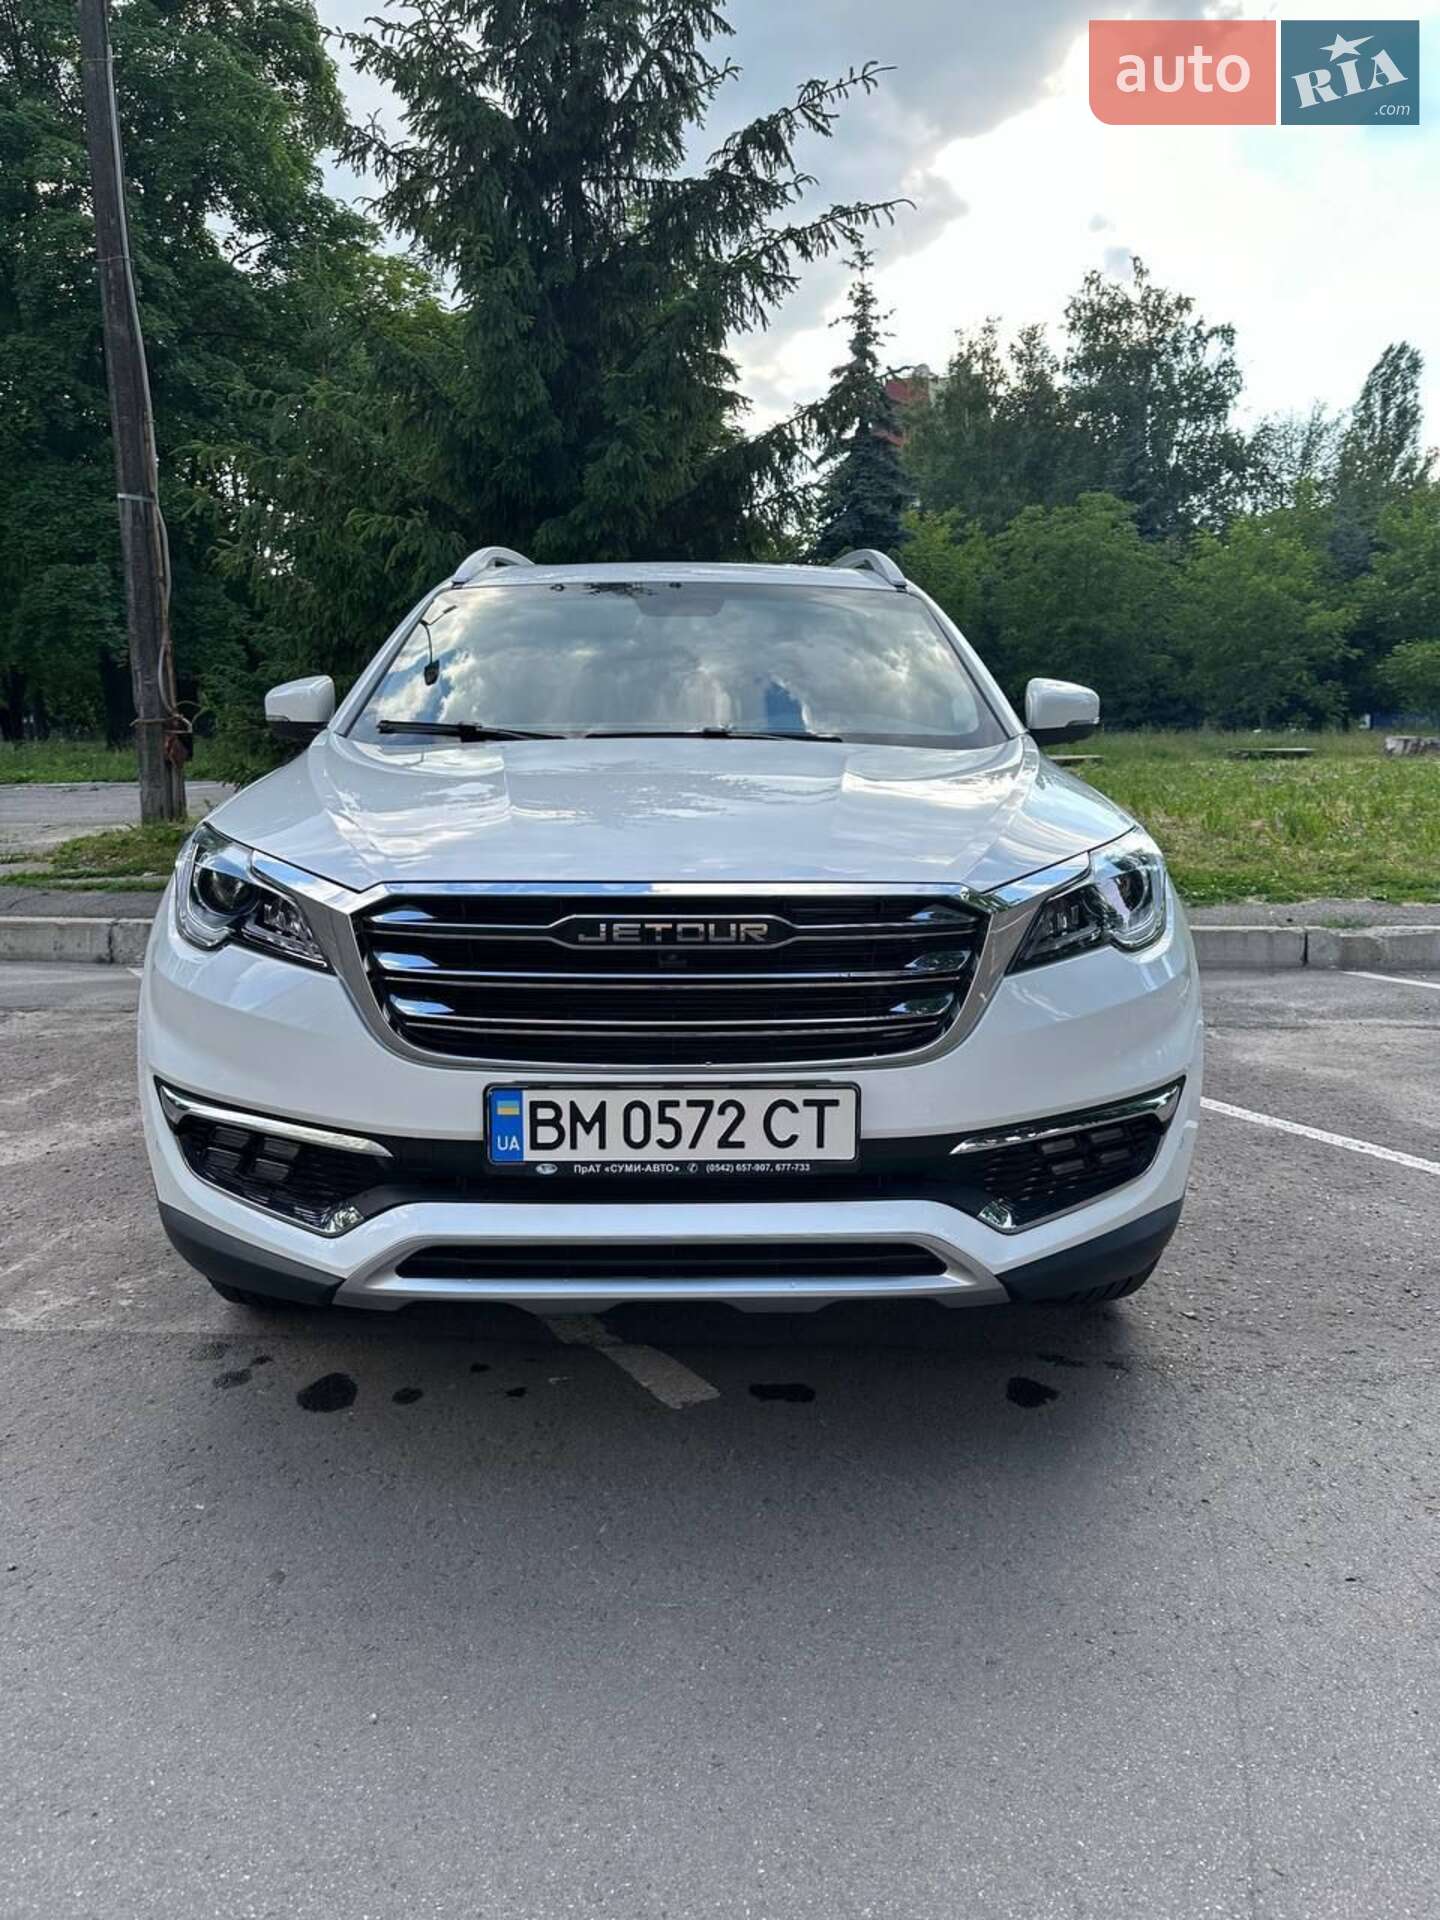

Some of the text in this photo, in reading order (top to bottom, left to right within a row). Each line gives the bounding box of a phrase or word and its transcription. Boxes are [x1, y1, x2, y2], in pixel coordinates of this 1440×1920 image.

[577, 922, 769, 943] JETOUR
[528, 1099, 840, 1151] BM 0572 CT
[496, 1136, 520, 1152] UA
[574, 1163, 601, 1175] ПрАТ
